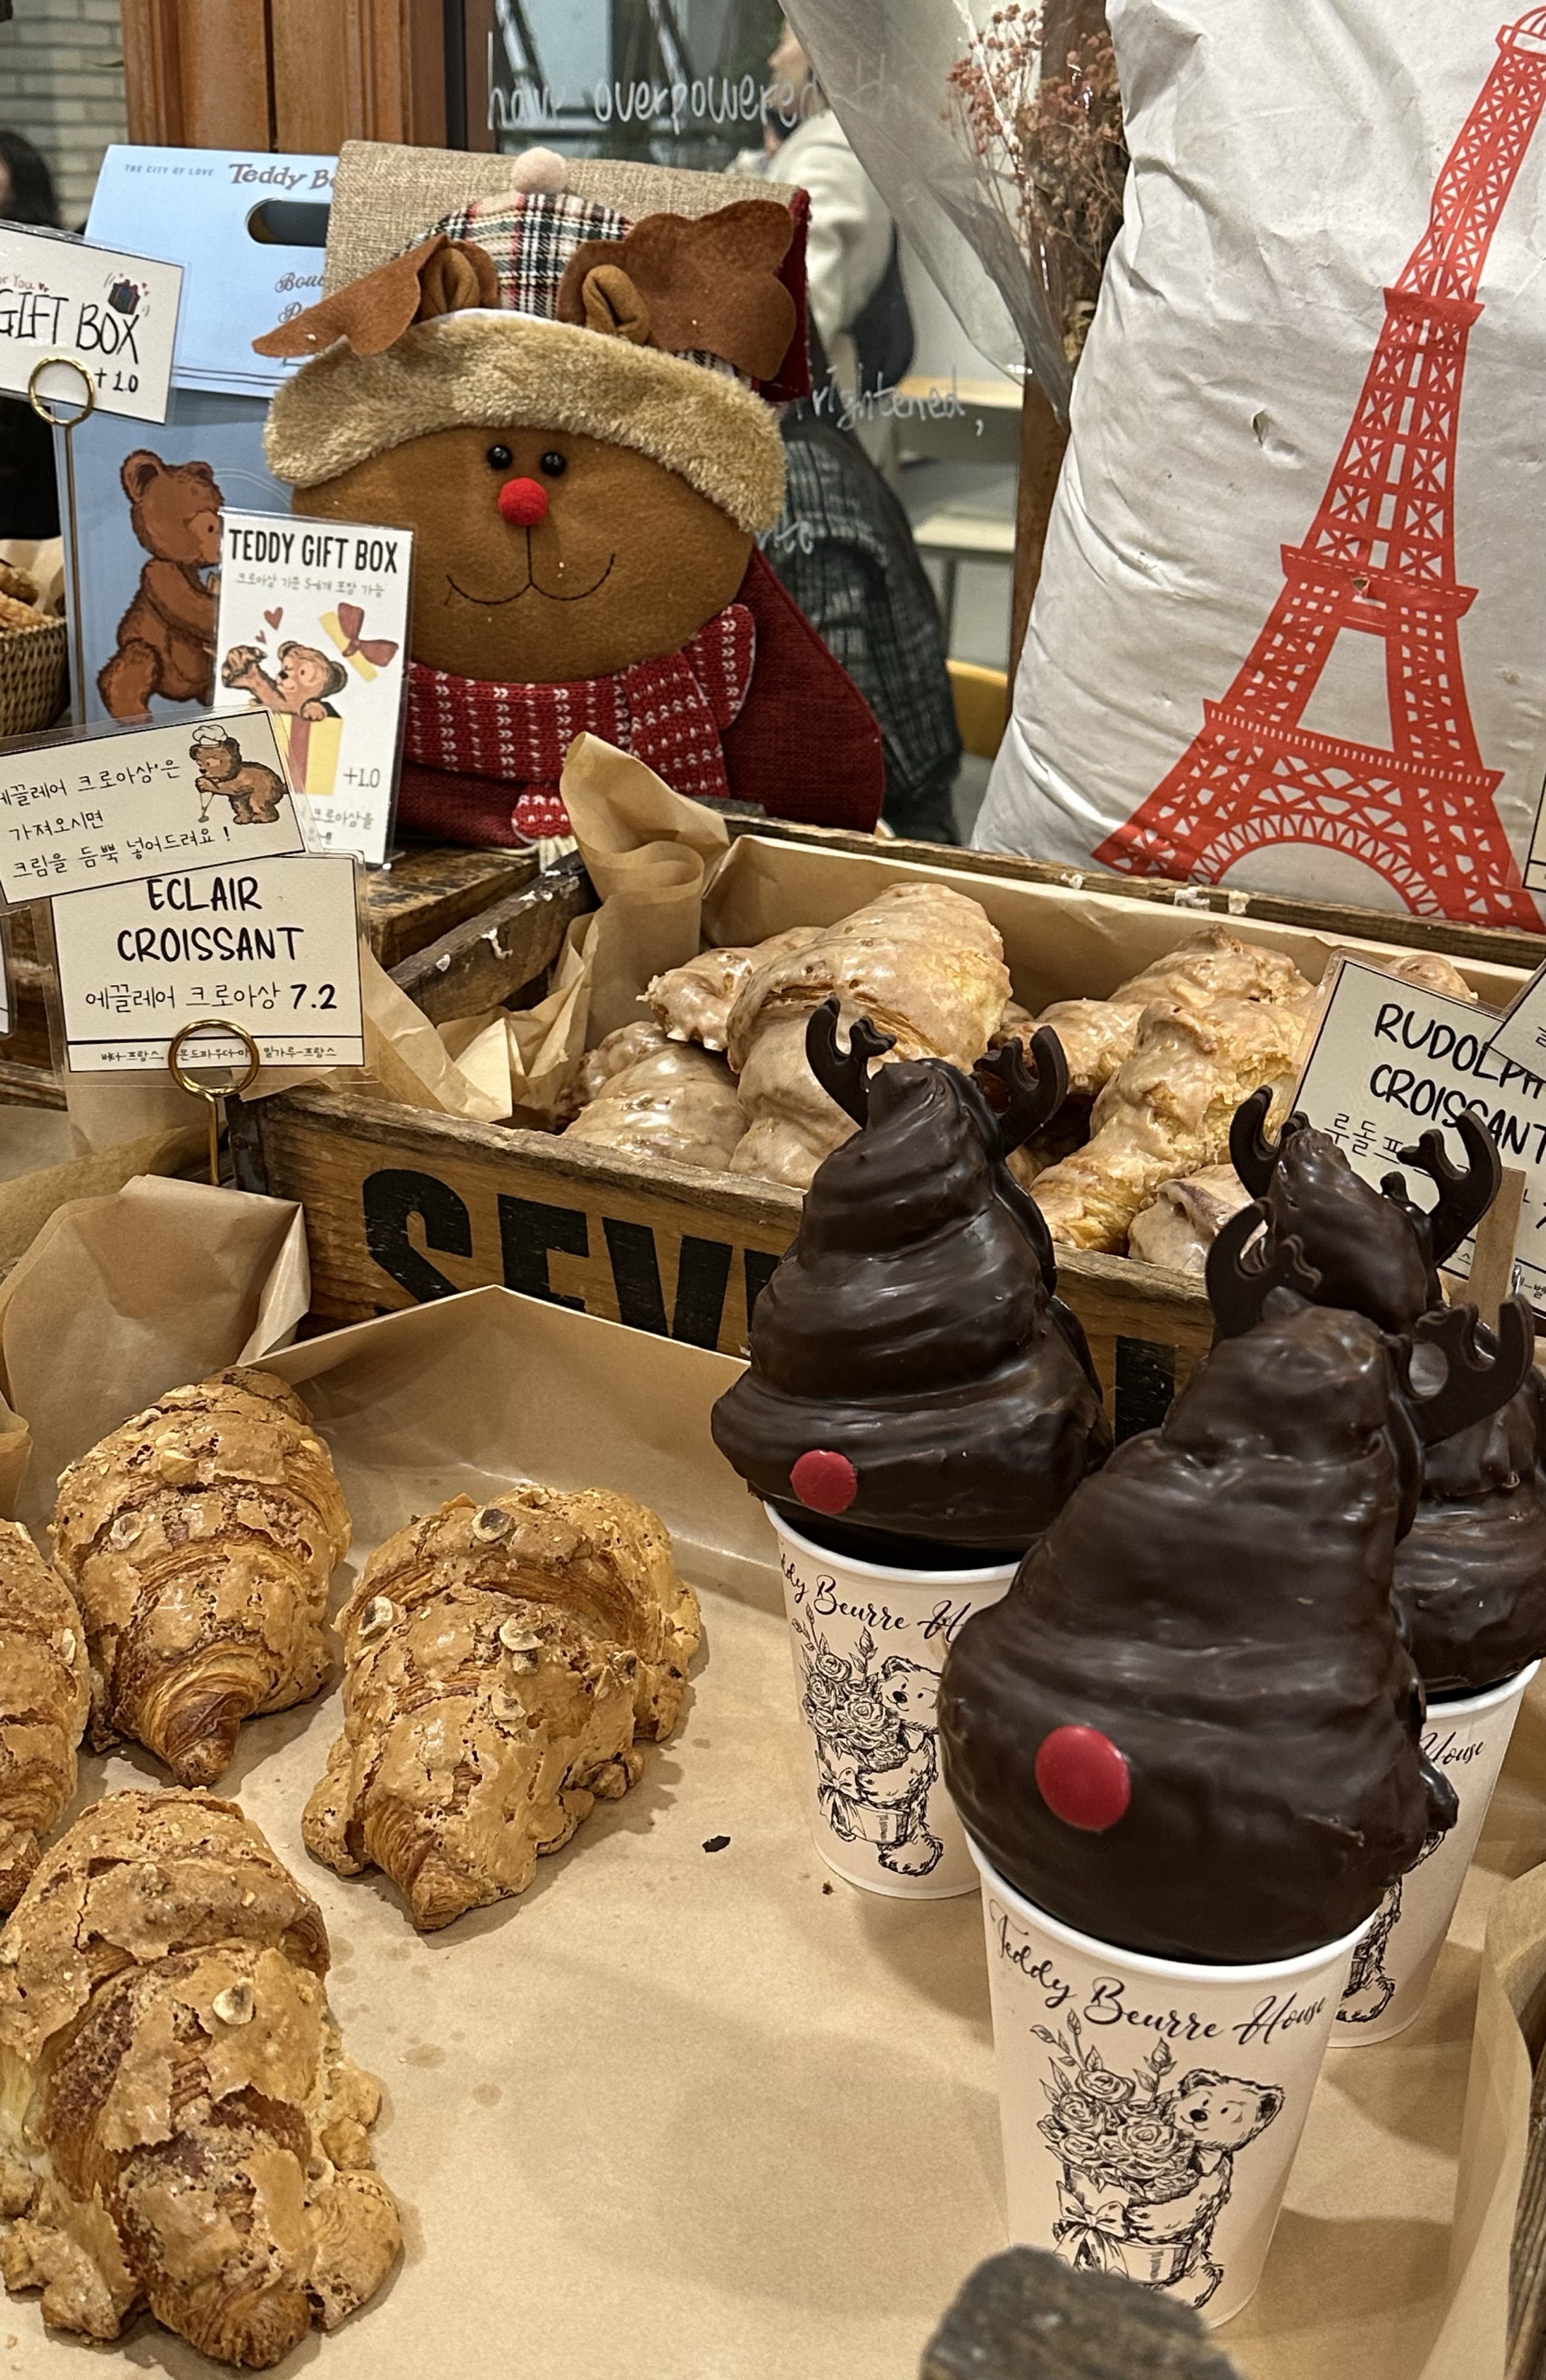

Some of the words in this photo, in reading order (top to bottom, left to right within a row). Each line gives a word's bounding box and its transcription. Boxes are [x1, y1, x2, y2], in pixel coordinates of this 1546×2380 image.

[125, 165, 142, 173] THE
[146, 165, 168, 173] CITY
[189, 168, 214, 177] LOVE
[229, 164, 308, 190] Teddy
[75, 303, 140, 364] BOX
[229, 529, 294, 564] TEDDY
[302, 534, 349, 569] GIFT
[355, 539, 397, 573] BOX
[361, 583, 385, 597] 가능
[9, 810, 104, 842] 가져오시면
[13, 852, 67, 878] 크림을
[78, 845, 118, 868] 듬뿍
[147, 876, 262, 912] ECLAIR
[116, 926, 305, 962] CROISSANT
[85, 984, 176, 1013] 에끌레어
[186, 981, 281, 1010] 크로아상
[289, 983, 338, 1011] 7.2
[814, 1575, 910, 1631] Beurre
[989, 1899, 1077, 2008] Teddy
[1084, 1976, 1224, 2039] Beurre
[1232, 1992, 1326, 2044] House
